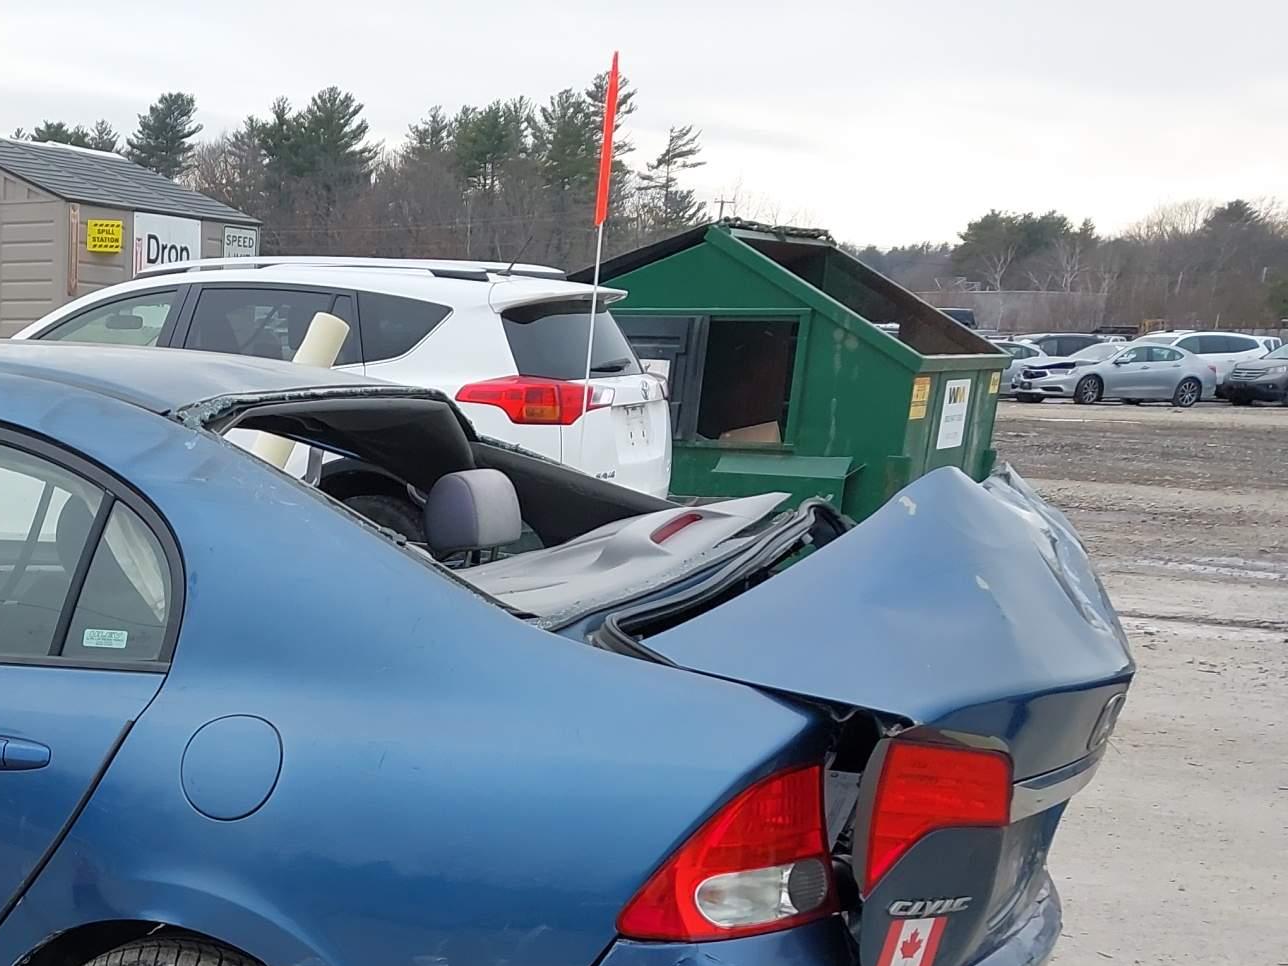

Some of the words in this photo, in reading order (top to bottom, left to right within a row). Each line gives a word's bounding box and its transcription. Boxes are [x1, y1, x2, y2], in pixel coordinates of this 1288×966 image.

[225, 234, 254, 249] SPEED
[948, 386, 966, 405] WM
[888, 896, 973, 918] CIVIC
